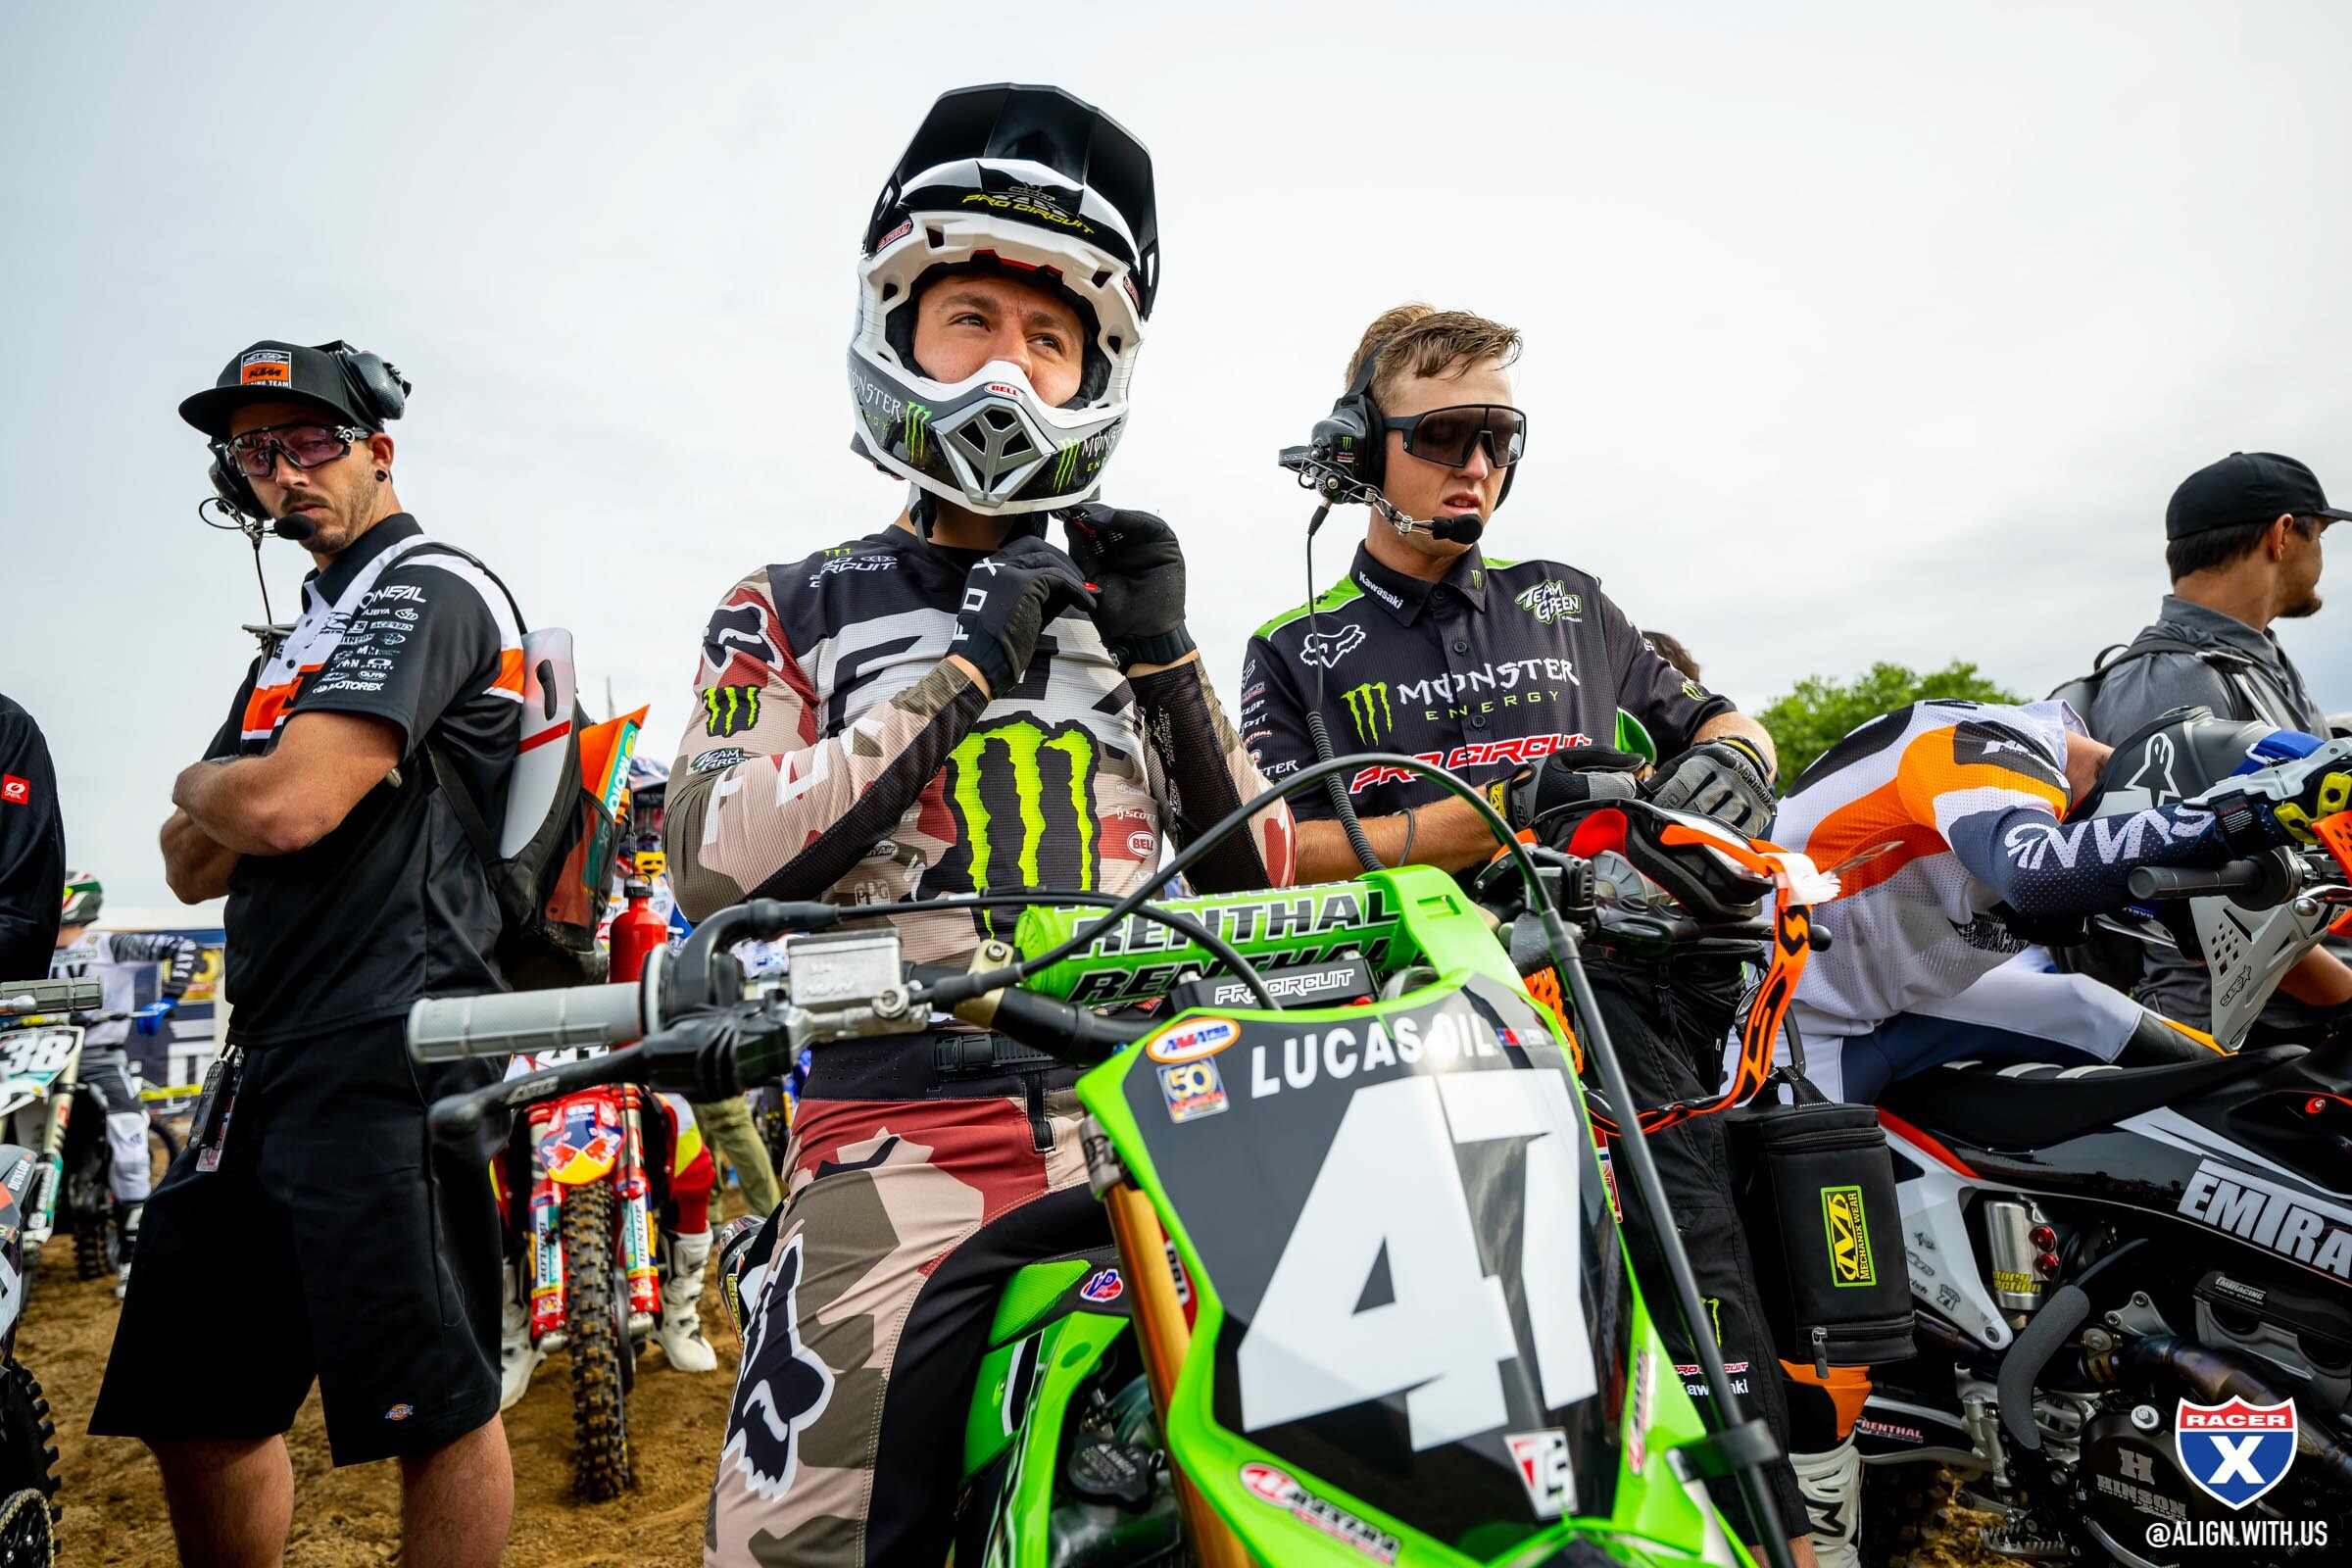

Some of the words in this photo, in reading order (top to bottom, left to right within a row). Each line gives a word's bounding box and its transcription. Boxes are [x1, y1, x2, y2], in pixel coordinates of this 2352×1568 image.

[961, 194, 1011, 208] PRO
[1012, 203, 1095, 234] CIRCUIT
[850, 368, 902, 423] ONSTER
[991, 385, 1018, 396] BELL
[953, 558, 1005, 641] FOX
[1358, 571, 1404, 610] Kawasaki
[1516, 581, 1563, 609] TEAM
[1536, 596, 1580, 621] GREEN
[327, 680, 384, 691] MOTOREX
[1396, 658, 1580, 706] MONSTER
[1425, 690, 1559, 721] ENERGY
[692, 749, 740, 767] TEAM
[1132, 837, 1153, 851] BELL
[1067, 888, 1403, 960] RENTHAL
[1250, 1015, 1422, 1100] LUCAS
[1423, 1011, 1500, 1066] OIL
[1168, 1063, 1213, 1100] 50
[7, 1158, 31, 1193] DUNLOP
[1847, 1192, 1861, 1223] WEAR
[1237, 1068, 1598, 1452] 47
[1854, 1224, 1871, 1280] MECHANIX
[1861, 1419, 1924, 1439] RENTHAL
[2096, 1474, 2186, 1518] HINSON
